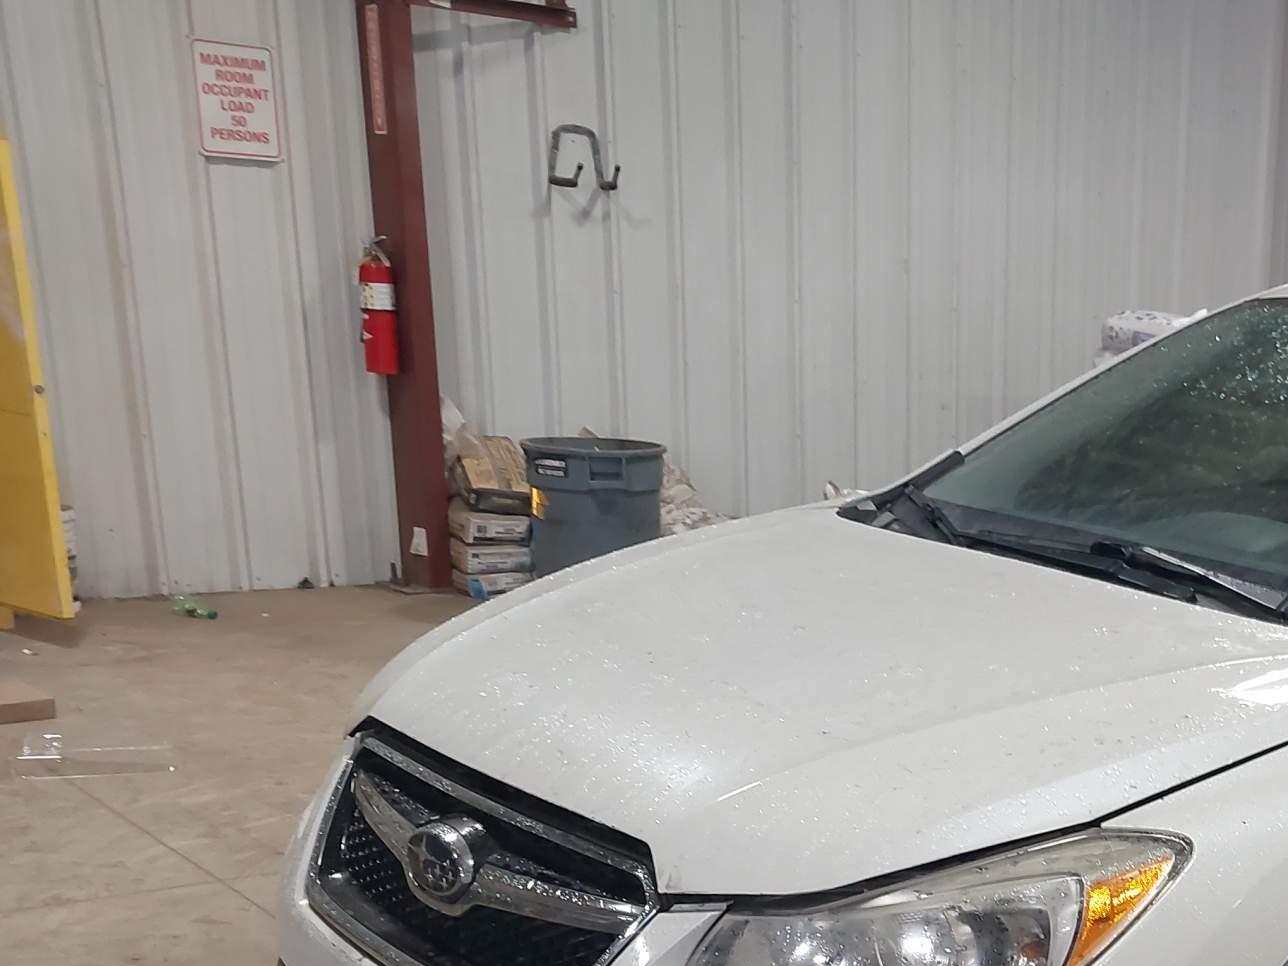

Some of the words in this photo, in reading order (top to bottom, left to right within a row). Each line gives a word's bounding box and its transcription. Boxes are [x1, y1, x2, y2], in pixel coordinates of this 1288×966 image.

[199, 52, 266, 72] MAXIMUM
[215, 69, 255, 84] ROOM
[201, 82, 269, 101] OCCUPANT
[220, 99, 255, 114] LOAD
[231, 114, 247, 128] 50
[210, 126, 270, 145] PERSONS
